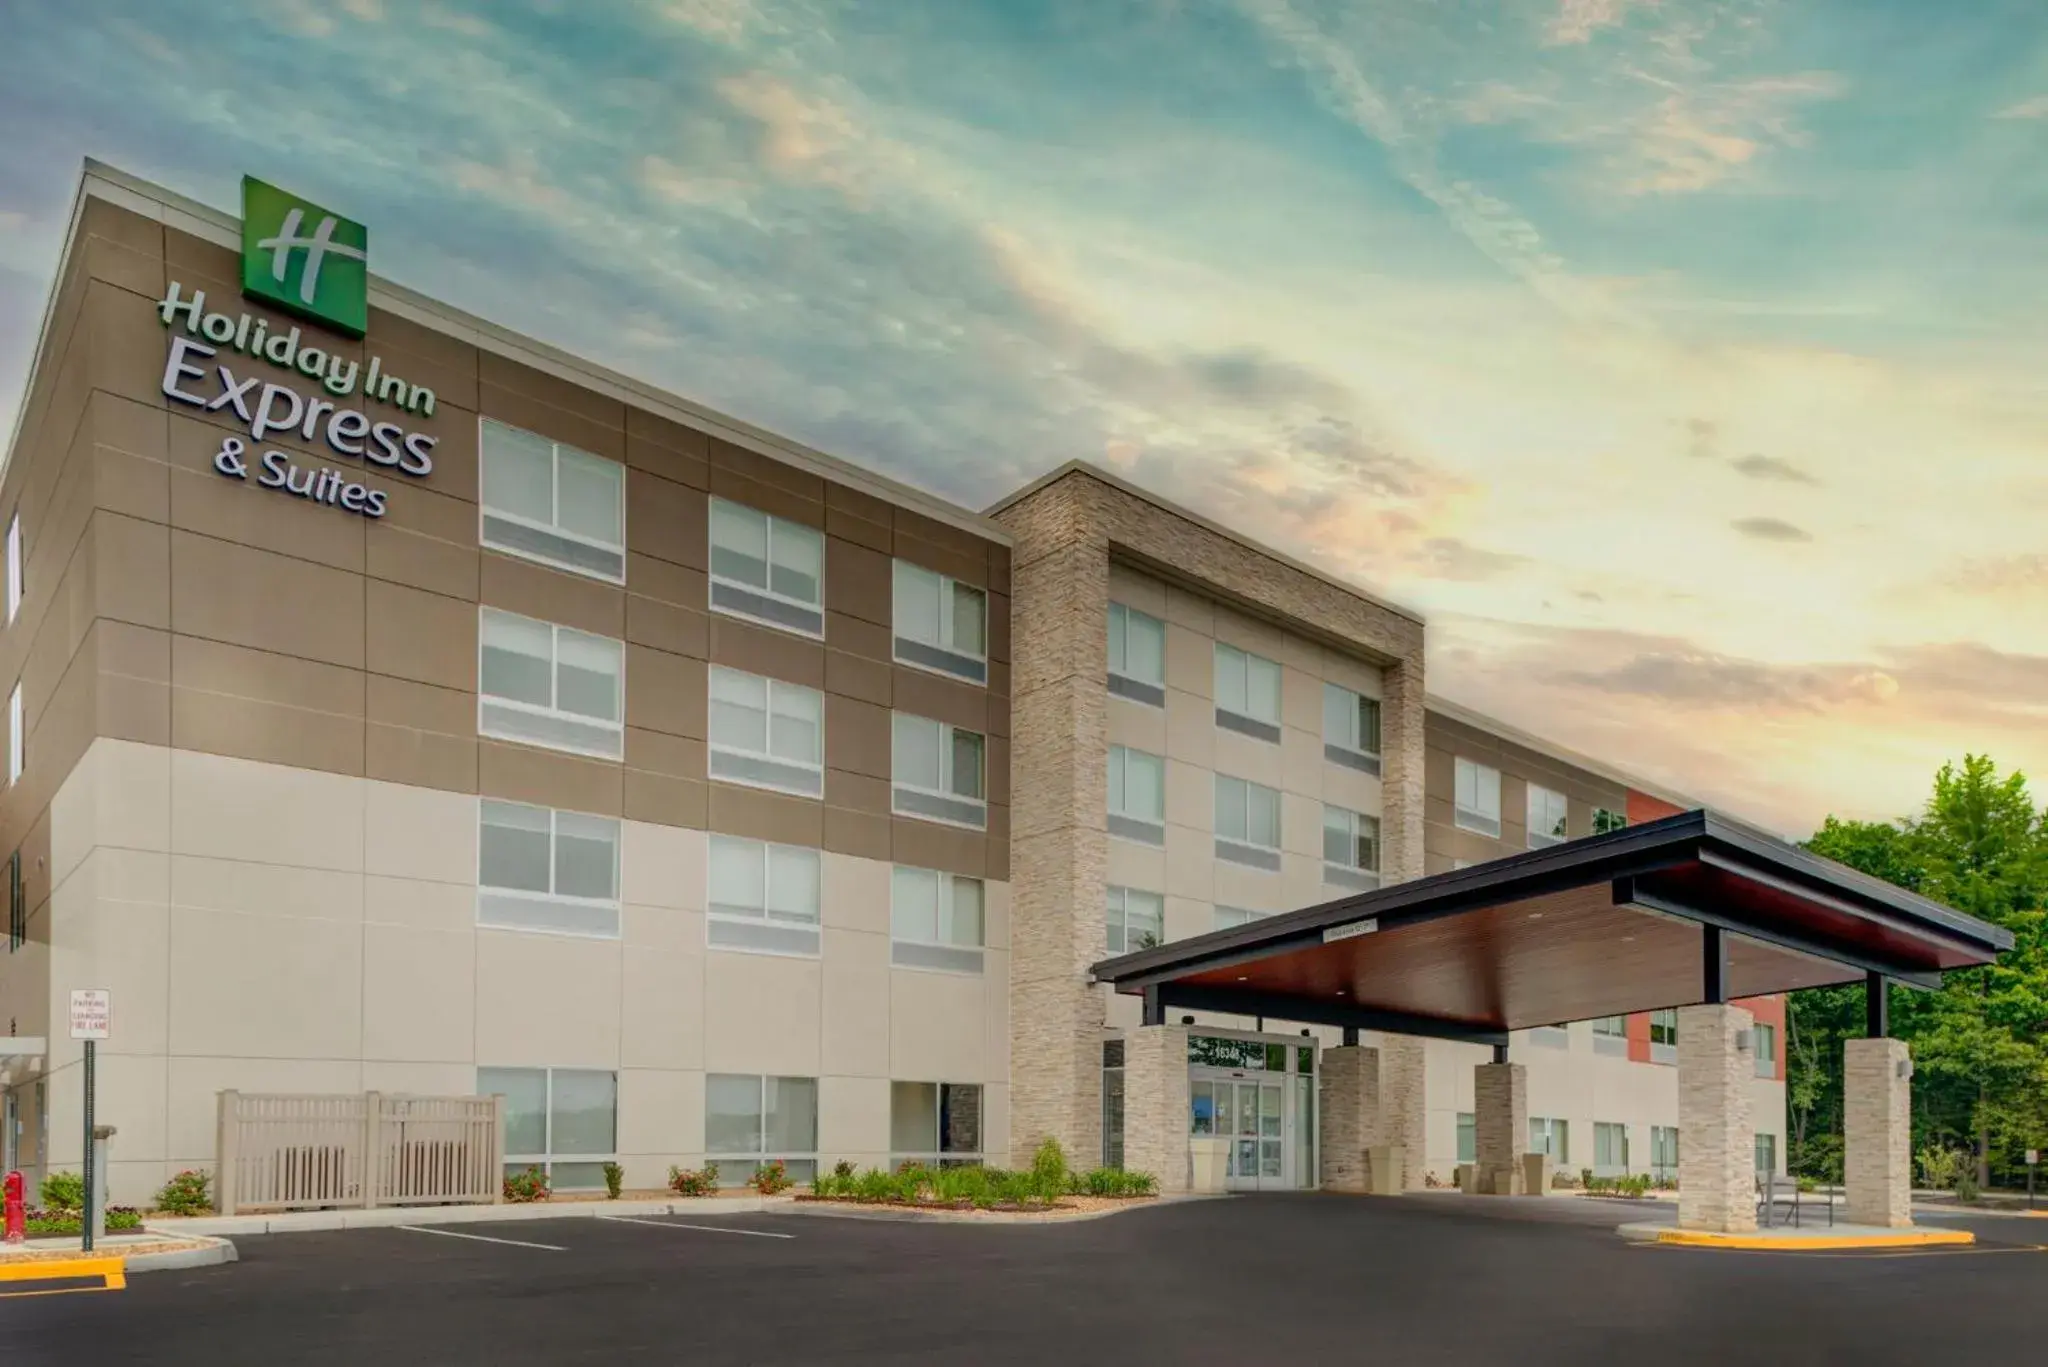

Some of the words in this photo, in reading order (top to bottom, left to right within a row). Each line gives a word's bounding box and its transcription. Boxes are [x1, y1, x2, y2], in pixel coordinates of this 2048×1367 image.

[158, 281, 359, 395] Holiday
[364, 356, 436, 417] Inn
[162, 336, 434, 477] Express
[214, 437, 248, 479] &
[257, 451, 388, 518] Suites
